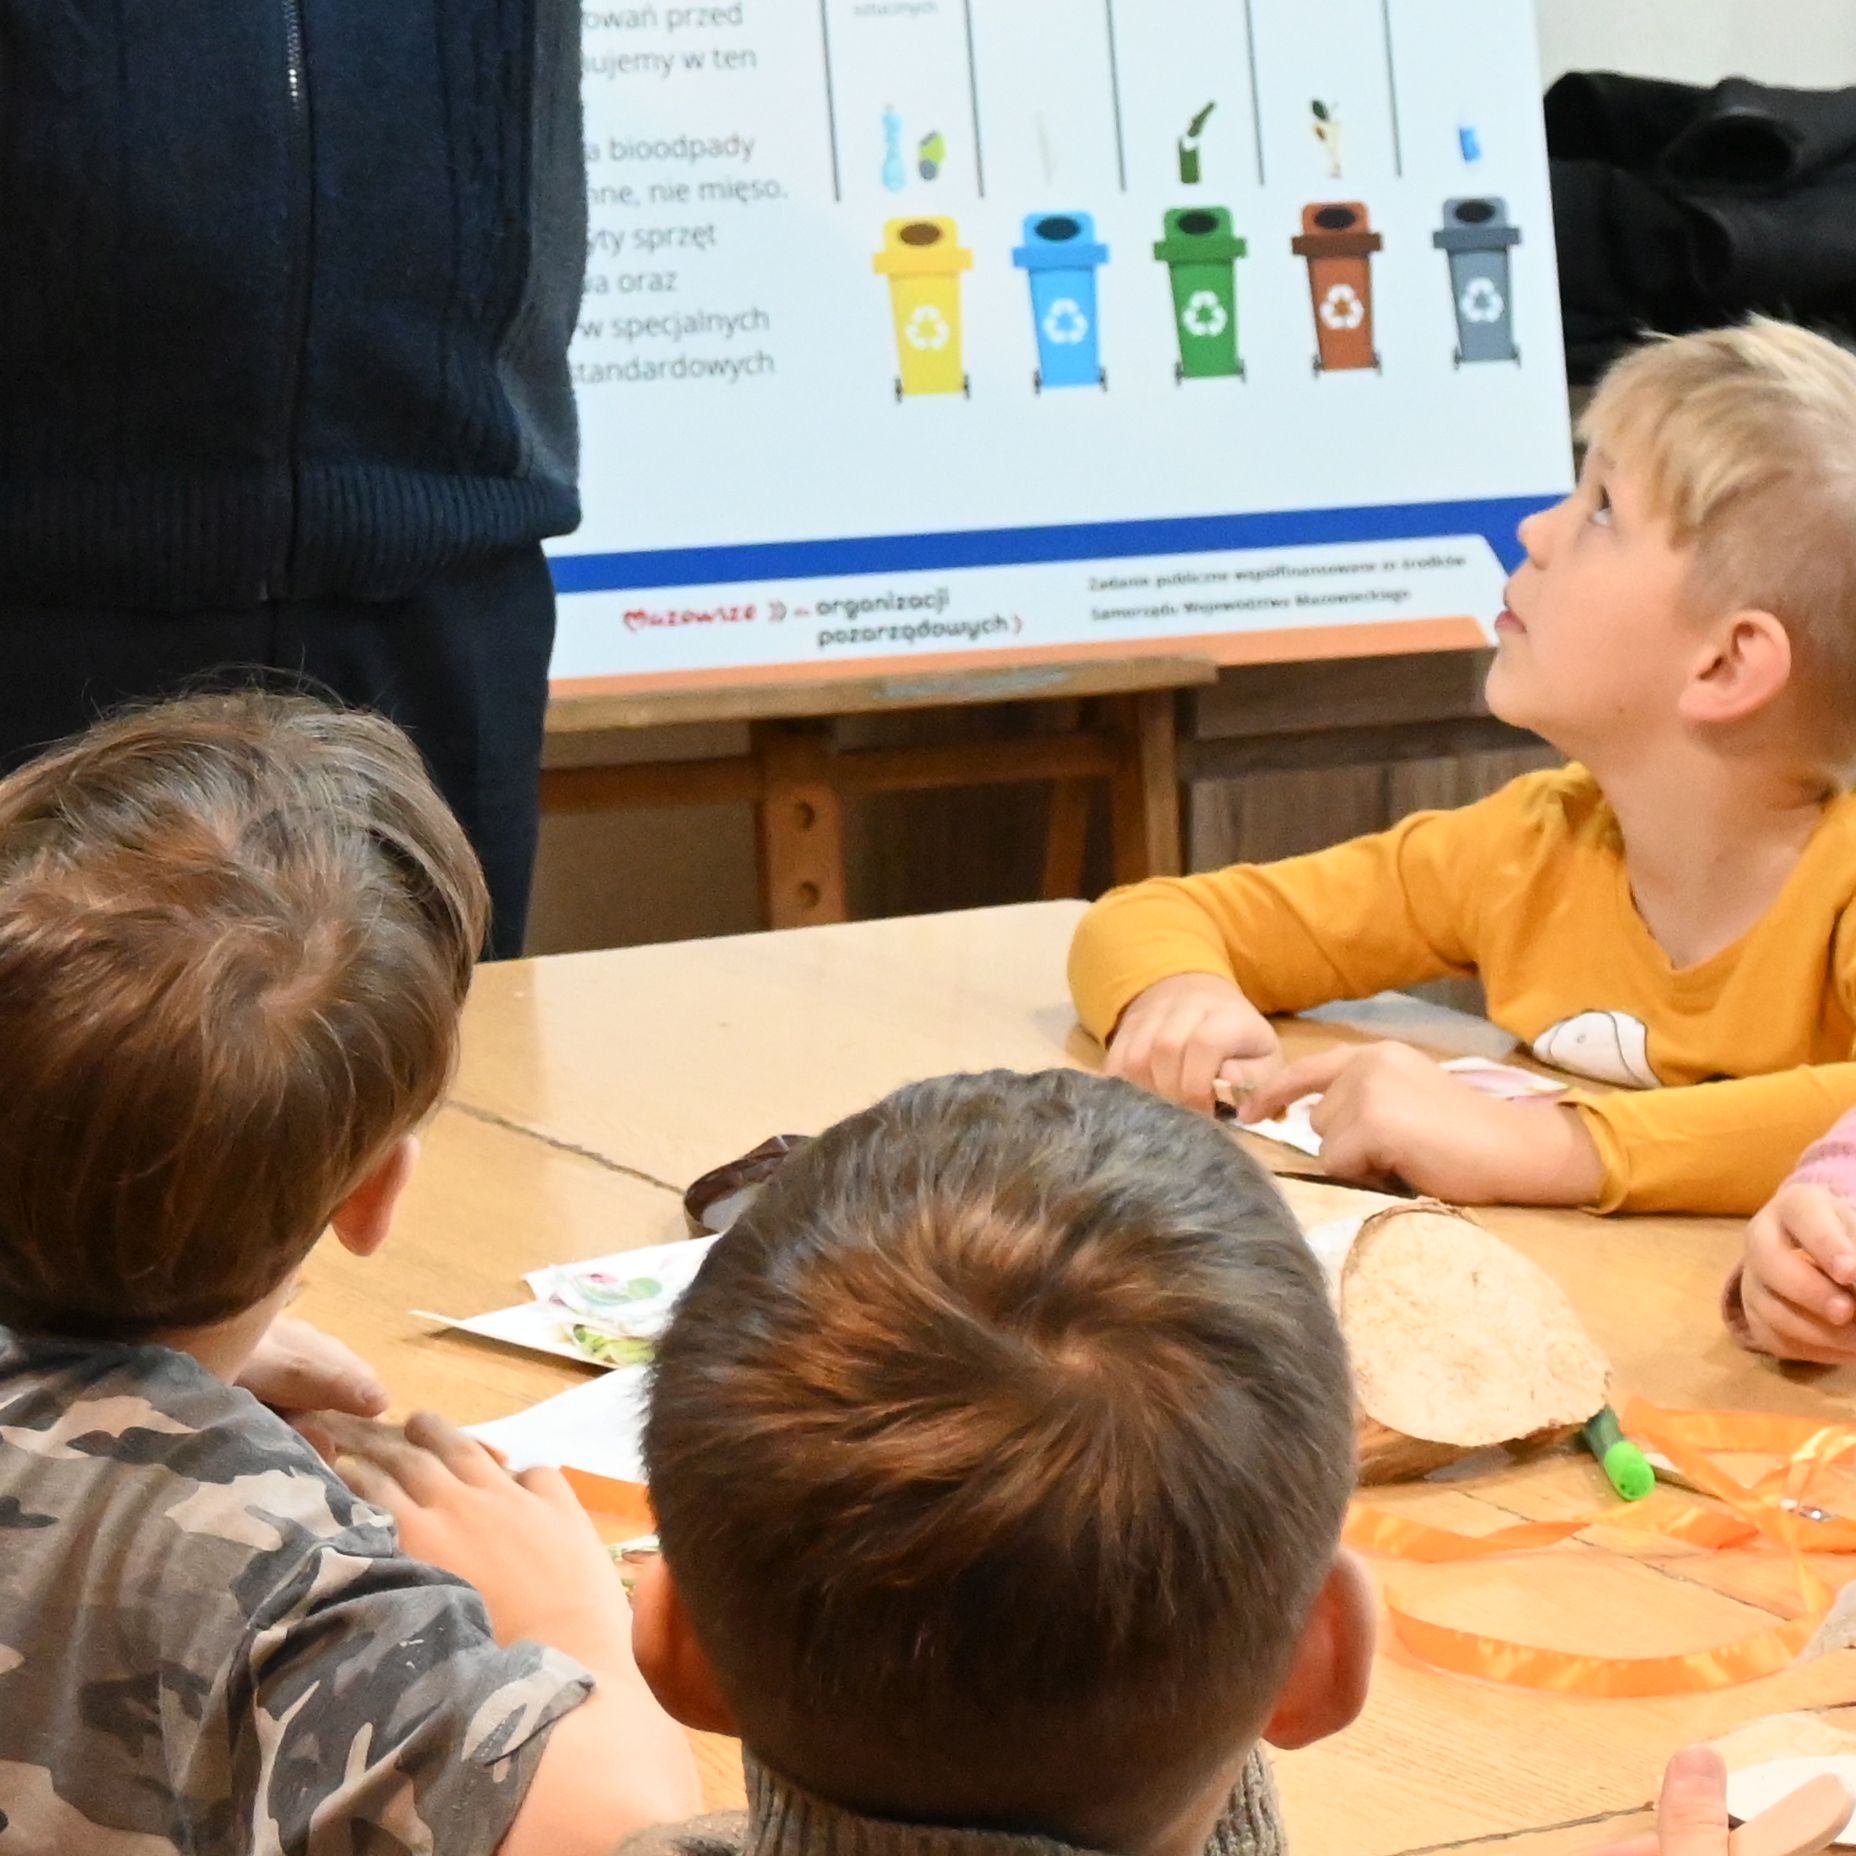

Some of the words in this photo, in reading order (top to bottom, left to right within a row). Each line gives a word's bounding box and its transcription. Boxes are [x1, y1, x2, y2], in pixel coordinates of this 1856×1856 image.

[667, 1, 743, 32] przed
[683, 51, 704, 70] w
[713, 48, 756, 69] ten
[609, 134, 755, 165] bioodpady
[650, 182, 690, 202] nie
[698, 177, 788, 205] mięso.
[633, 224, 716, 253] sprzęt
[618, 272, 677, 292] oraz
[612, 307, 769, 342] specjalnych
[815, 587, 950, 620] organizacji
